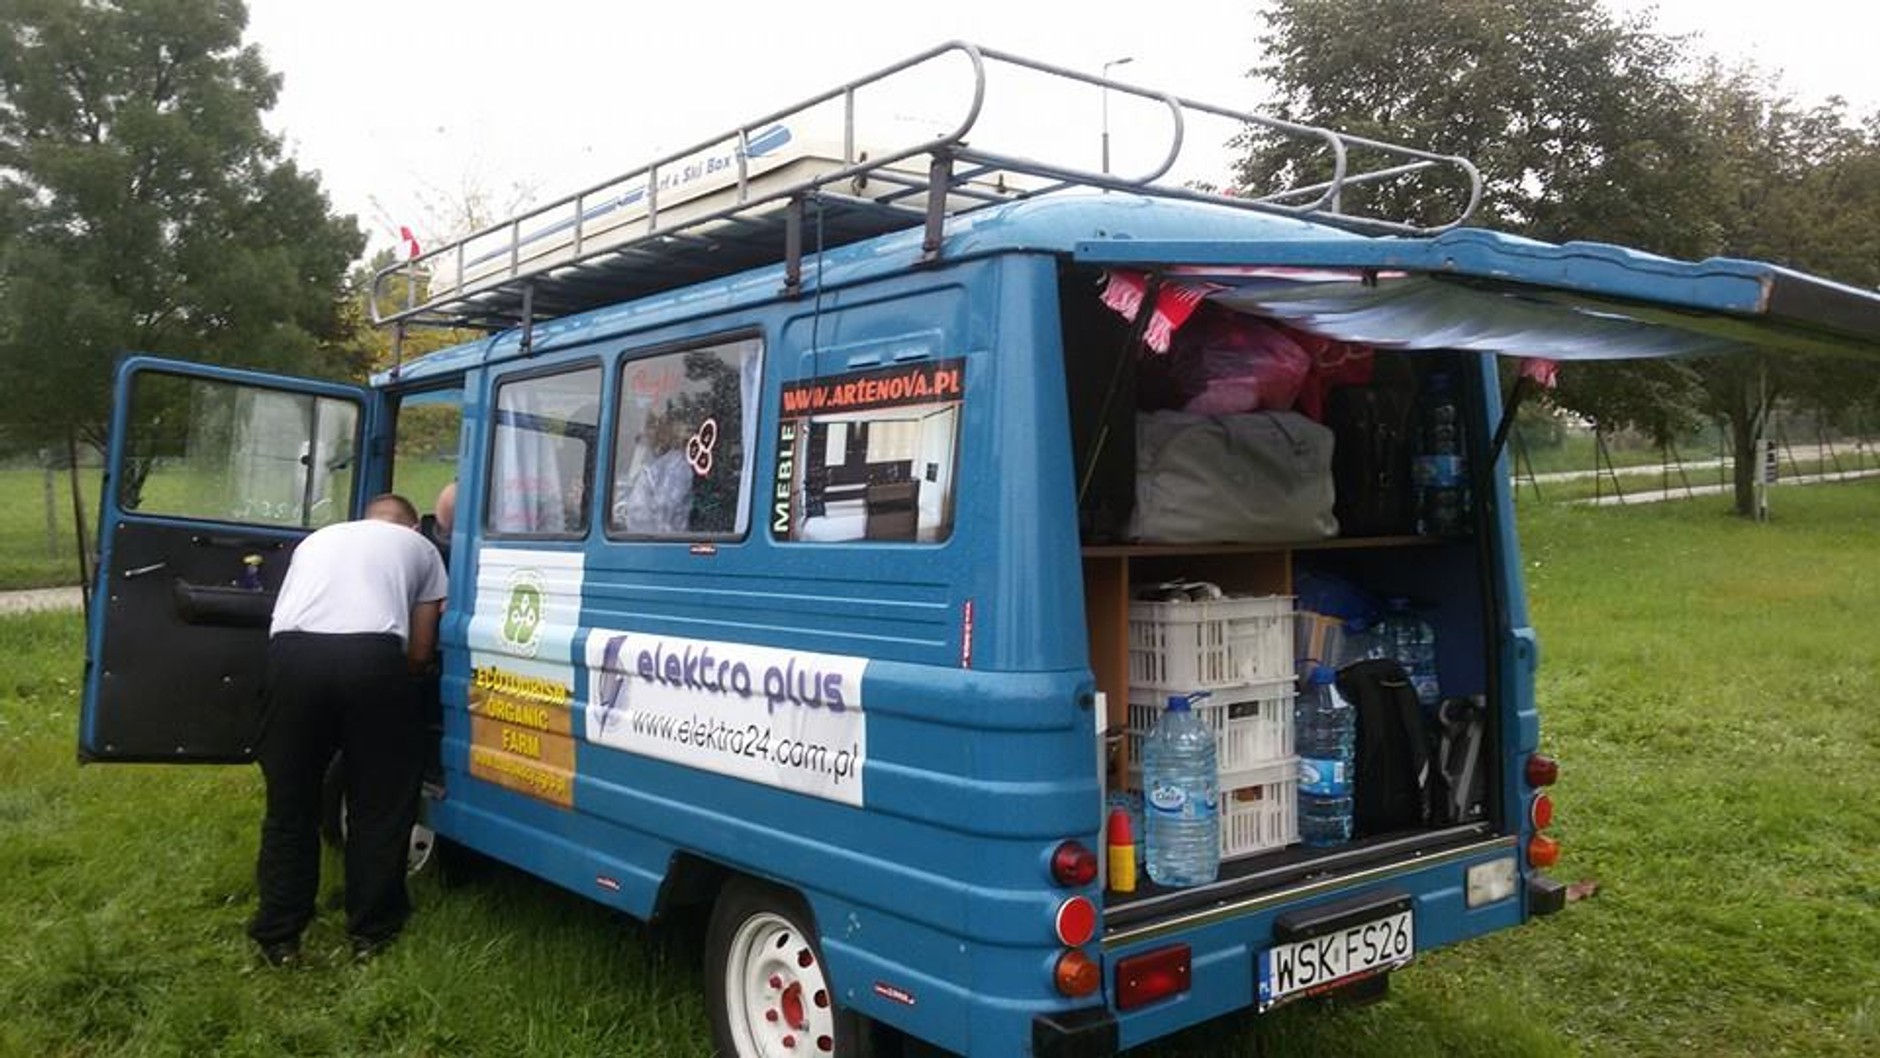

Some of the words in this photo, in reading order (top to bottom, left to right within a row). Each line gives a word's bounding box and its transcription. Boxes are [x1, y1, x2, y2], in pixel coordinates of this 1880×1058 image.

[706, 155, 732, 174] Box
[783, 370, 960, 412] WWW.ARTENOVA.PL
[773, 423, 797, 533] MEBLE
[636, 641, 752, 699] elektro
[763, 657, 846, 716] plus
[486, 697, 550, 732] ORGANIC
[501, 728, 541, 760] FARM
[631, 707, 859, 784] www.elektro24.com.pl
[1276, 936, 1336, 992] WSK
[1346, 915, 1409, 971] FS26
